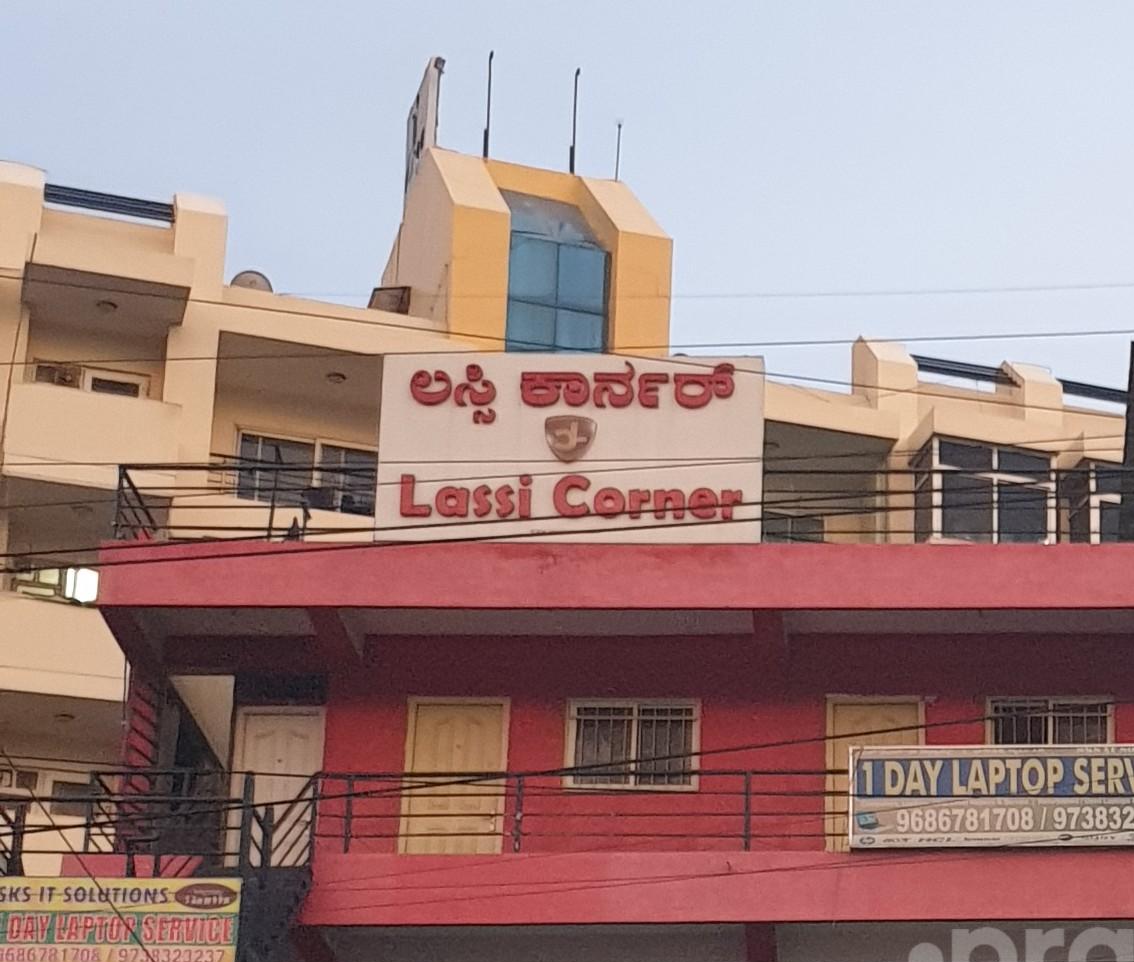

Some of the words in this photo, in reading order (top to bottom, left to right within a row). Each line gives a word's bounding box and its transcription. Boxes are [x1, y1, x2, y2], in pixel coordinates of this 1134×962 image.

[400, 473, 532, 519] Lassi
[553, 474, 743, 521] Corner
[861, 760, 874, 794] 1
[884, 760, 944, 795] DAY
[953, 758, 1064, 796] LAPTOP
[896, 807, 1035, 833] 9686781708
[39, 886, 57, 904] IT
[63, 886, 169, 905] SOLUTIONS
[7, 913, 50, 944] DAY
[55, 913, 137, 944] LAPTOP
[142, 912, 234, 944] SERVICE
